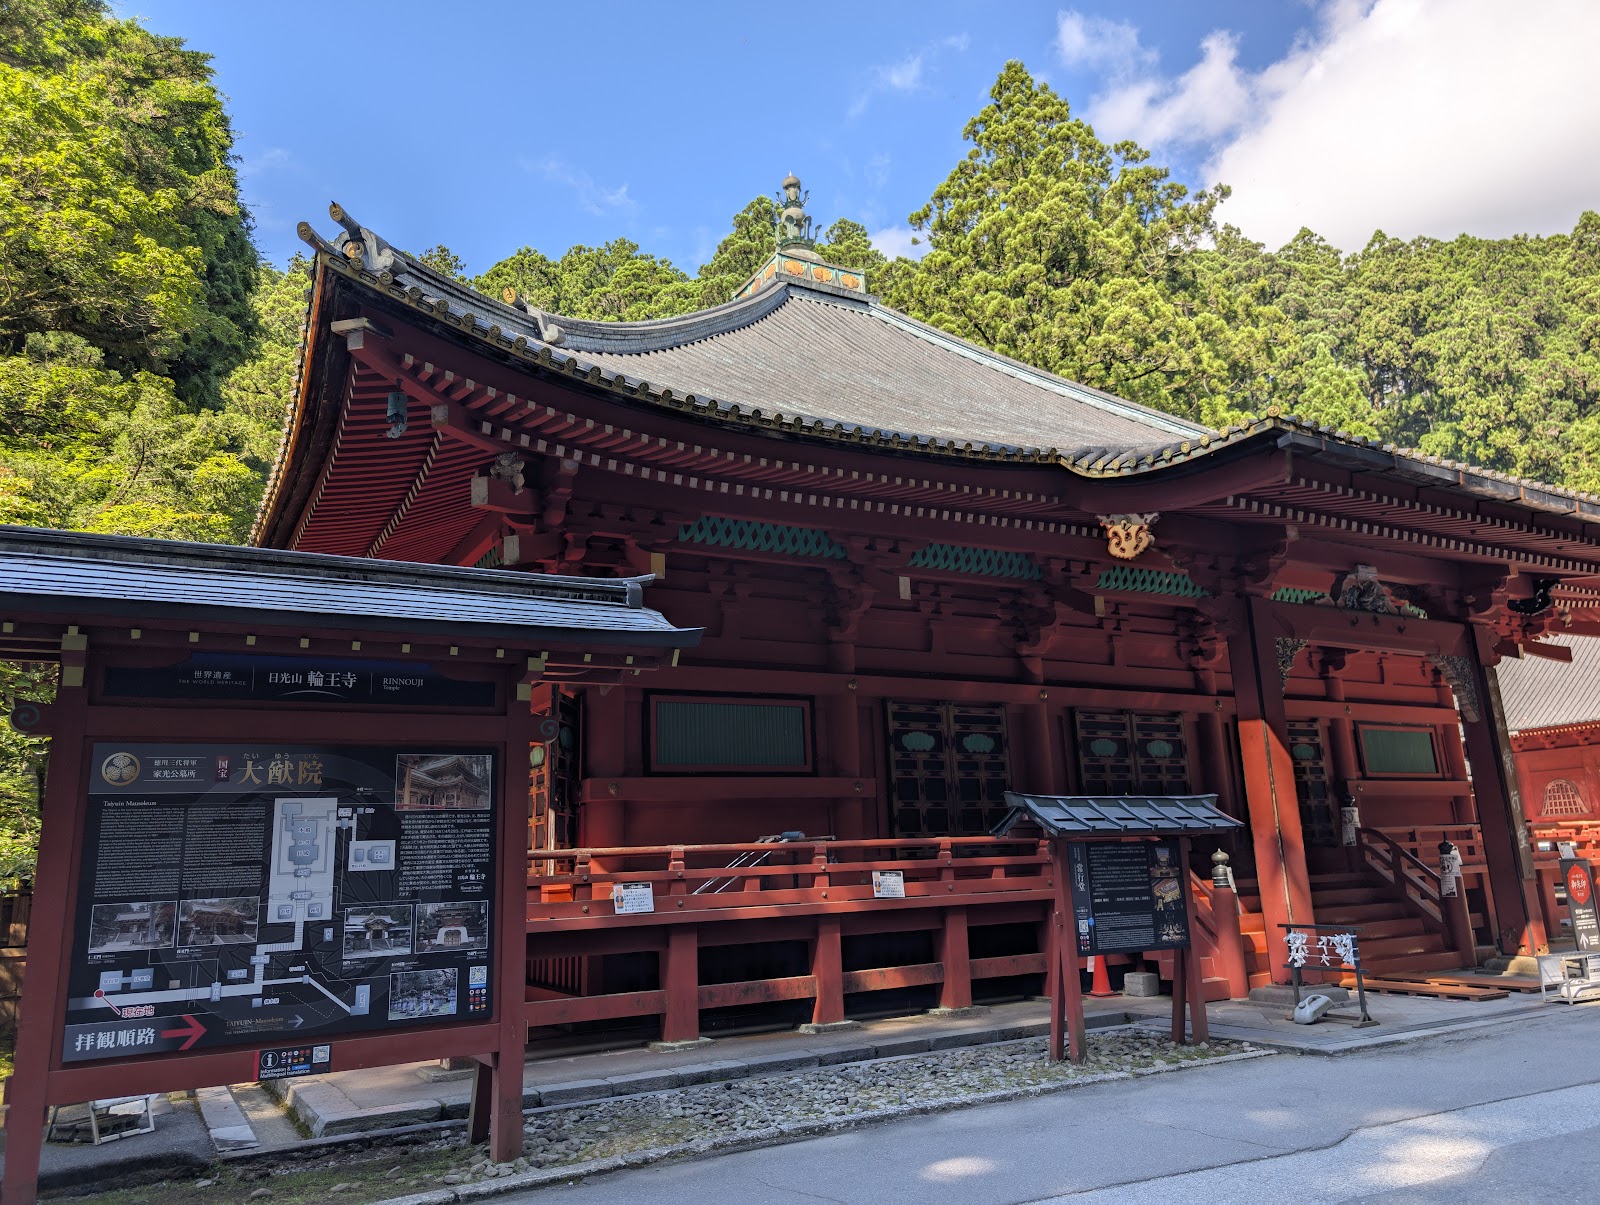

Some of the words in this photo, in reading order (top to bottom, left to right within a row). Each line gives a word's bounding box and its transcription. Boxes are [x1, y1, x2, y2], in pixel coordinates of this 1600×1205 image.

[193, 670, 232, 680] 世界遺産
[268, 672, 302, 684] 日光山
[307, 670, 358, 688] 輪王寺
[382, 678, 424, 687] RINNOUJI
[243, 752, 260, 760] たい
[275, 752, 290, 760] ゆう
[153, 769, 197, 778] 家光公墓所
[217, 760, 229, 778] 国宝
[236, 760, 324, 785] 大猷院
[103, 800, 125, 808] Taiyuin
[122, 1005, 155, 1018] 現在地
[75, 1027, 156, 1052] 拝観順路
[260, 1067, 287, 1075] Information
